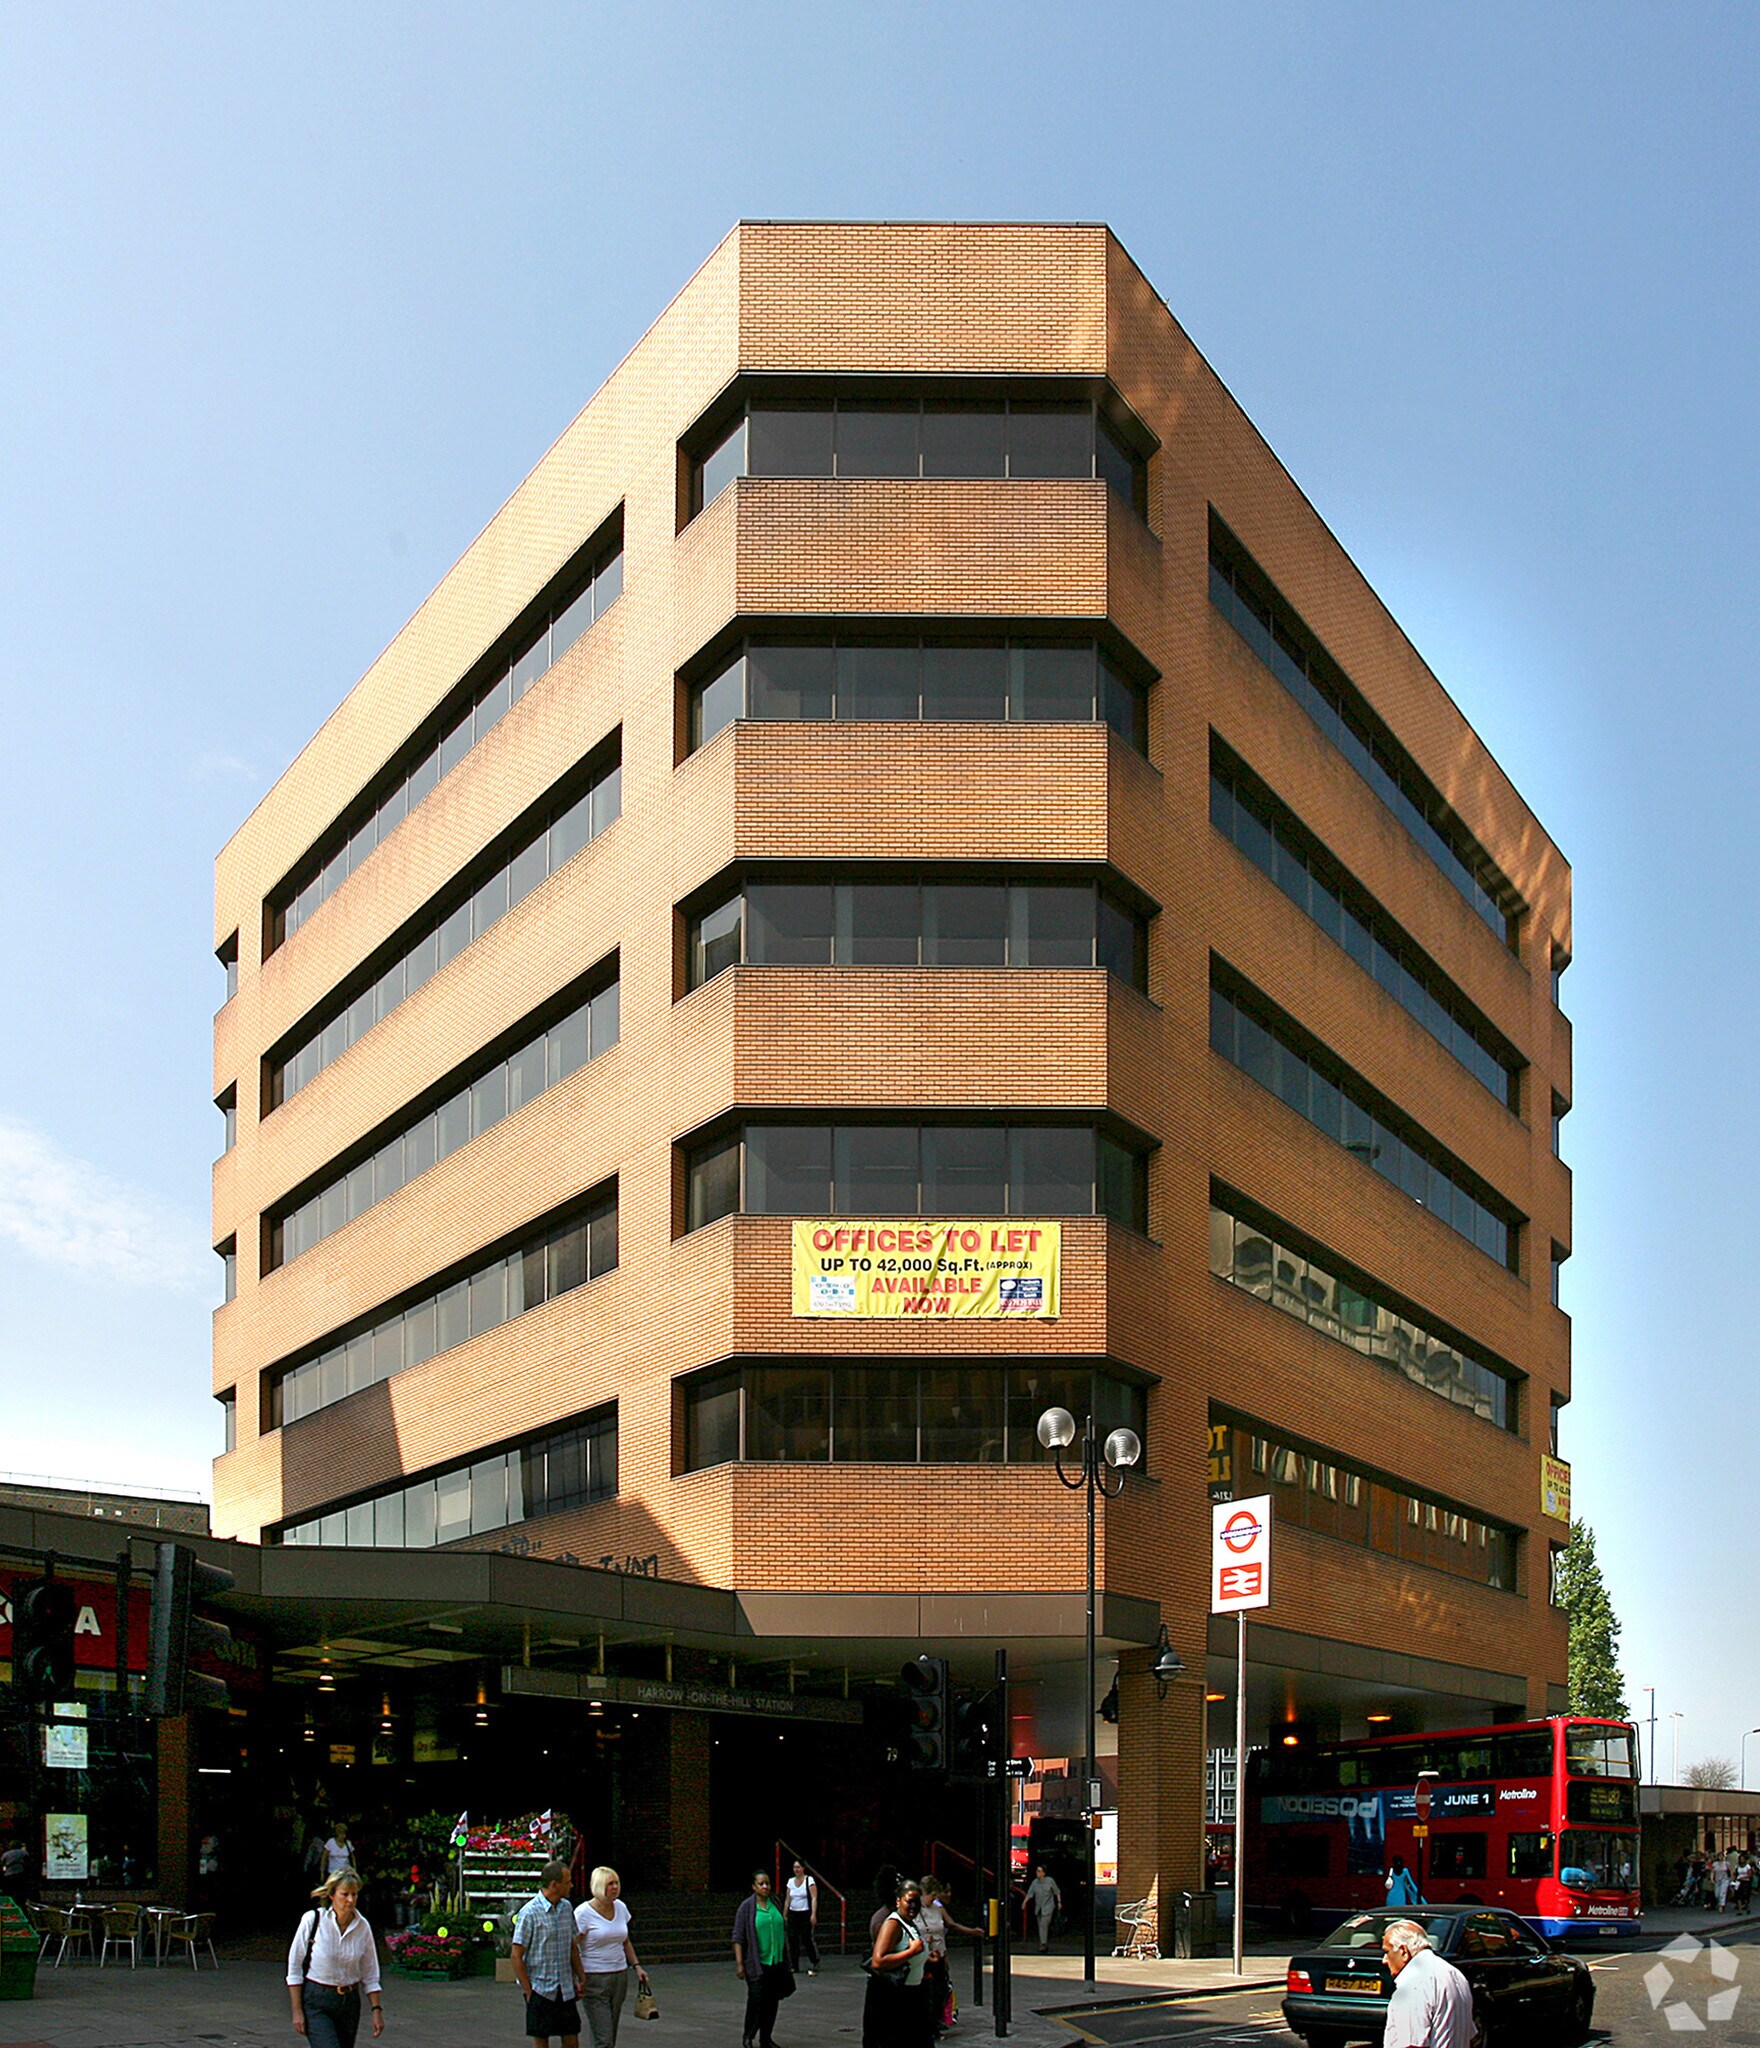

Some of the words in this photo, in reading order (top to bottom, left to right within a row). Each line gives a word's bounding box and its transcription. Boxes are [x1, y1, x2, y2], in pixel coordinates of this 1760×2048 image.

[812, 1229, 933, 1252] OFFICES
[945, 1230, 981, 1252] TO
[990, 1229, 1042, 1253] LET
[820, 1258, 845, 1272] UP
[849, 1258, 872, 1272] TO
[877, 1258, 932, 1273] 42,000
[937, 1258, 985, 1275] Sq.Ft.
[986, 1261, 1033, 1271] (APPROX)
[871, 1276, 983, 1294] AVAILABLE
[903, 1297, 951, 1314] NOW
[637, 1685, 683, 1702] HARROW
[754, 1698, 795, 1712] STATION
[1444, 1795, 1479, 1806] JUNE
[1482, 1793, 1490, 1804] 1
[1500, 1788, 1537, 1800] Metroline
[1276, 1796, 1378, 1818] POSEIDON
[1587, 1904, 1618, 1916] Metroline
